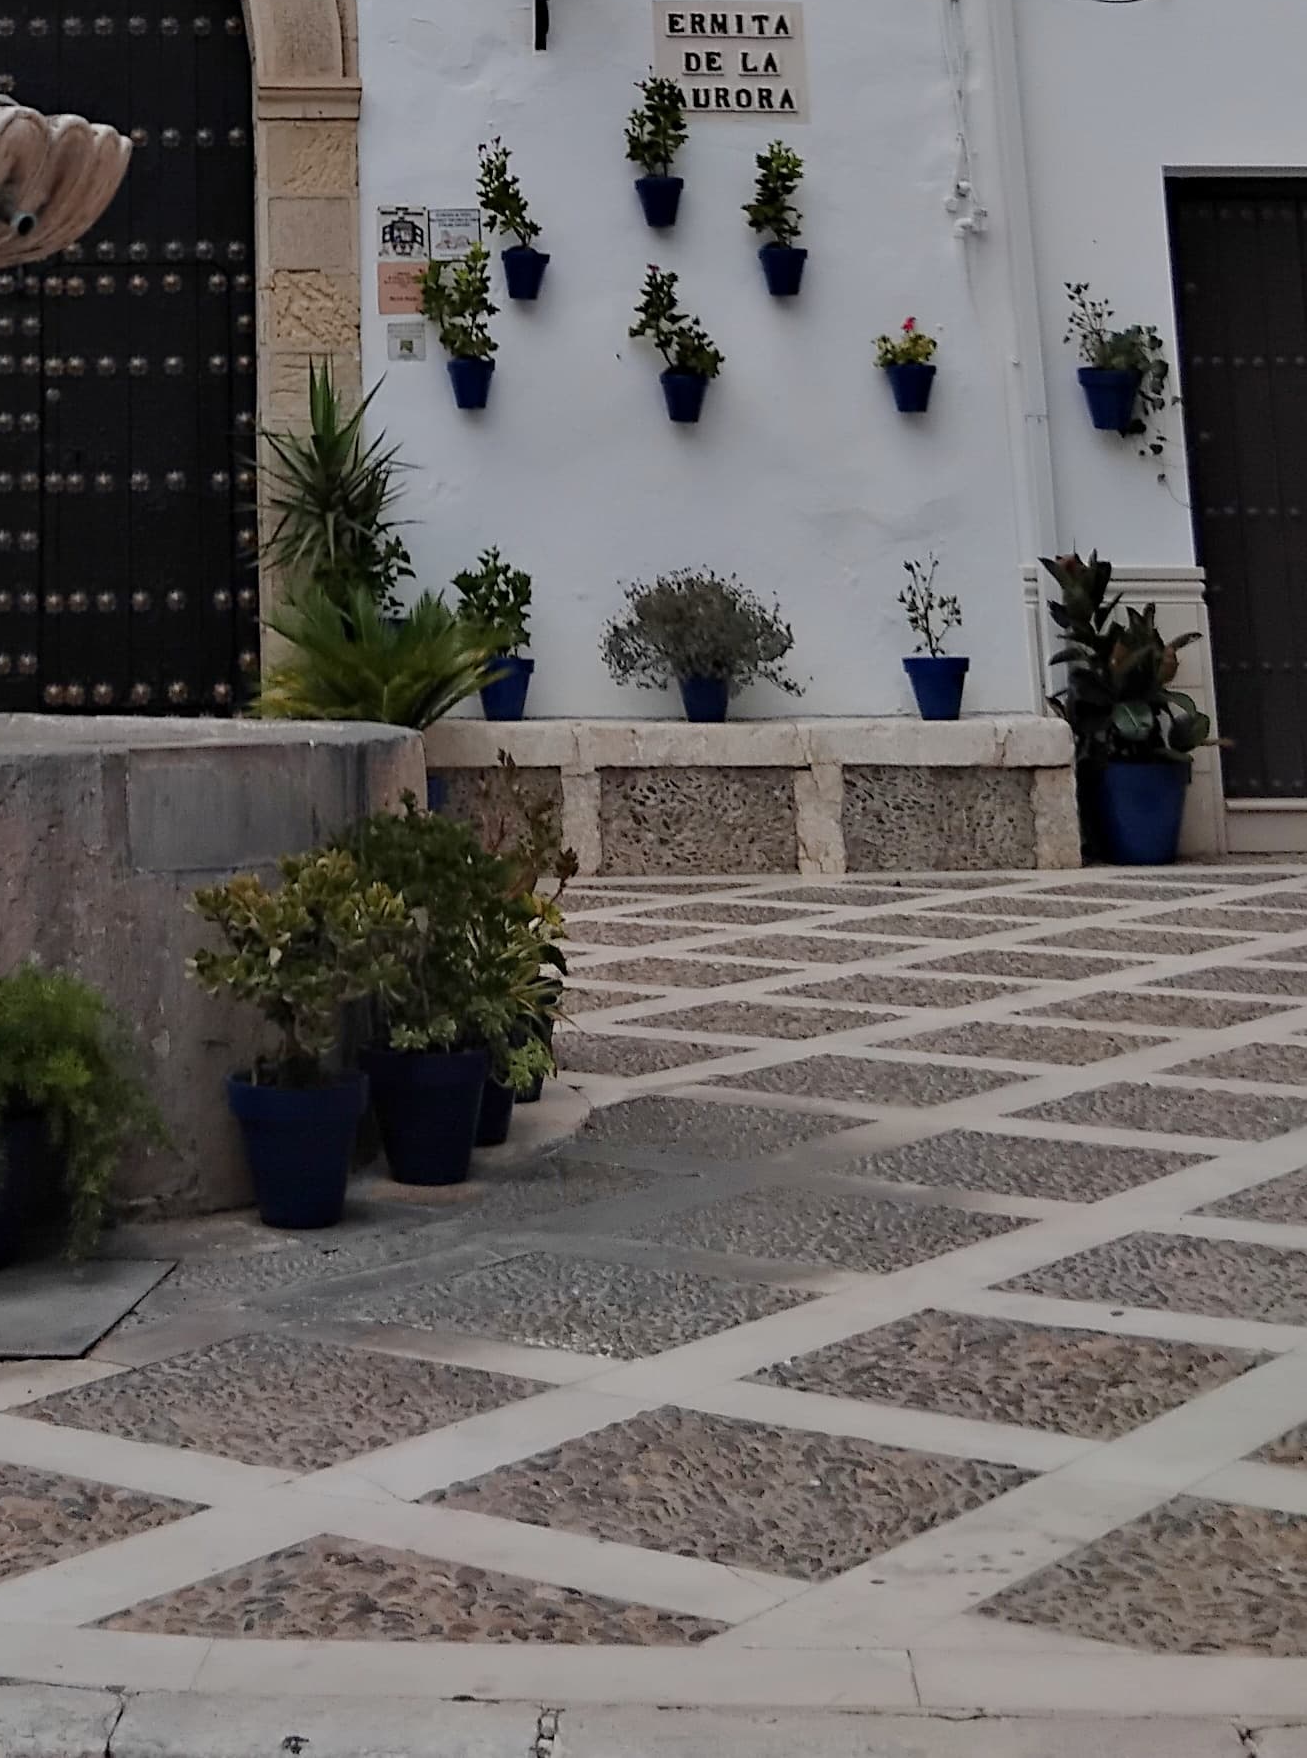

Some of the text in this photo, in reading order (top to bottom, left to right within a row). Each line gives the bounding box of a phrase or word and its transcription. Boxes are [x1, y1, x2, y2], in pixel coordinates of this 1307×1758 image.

[667, 13, 790, 35] ERMITA
[684, 51, 778, 73] DE LA
